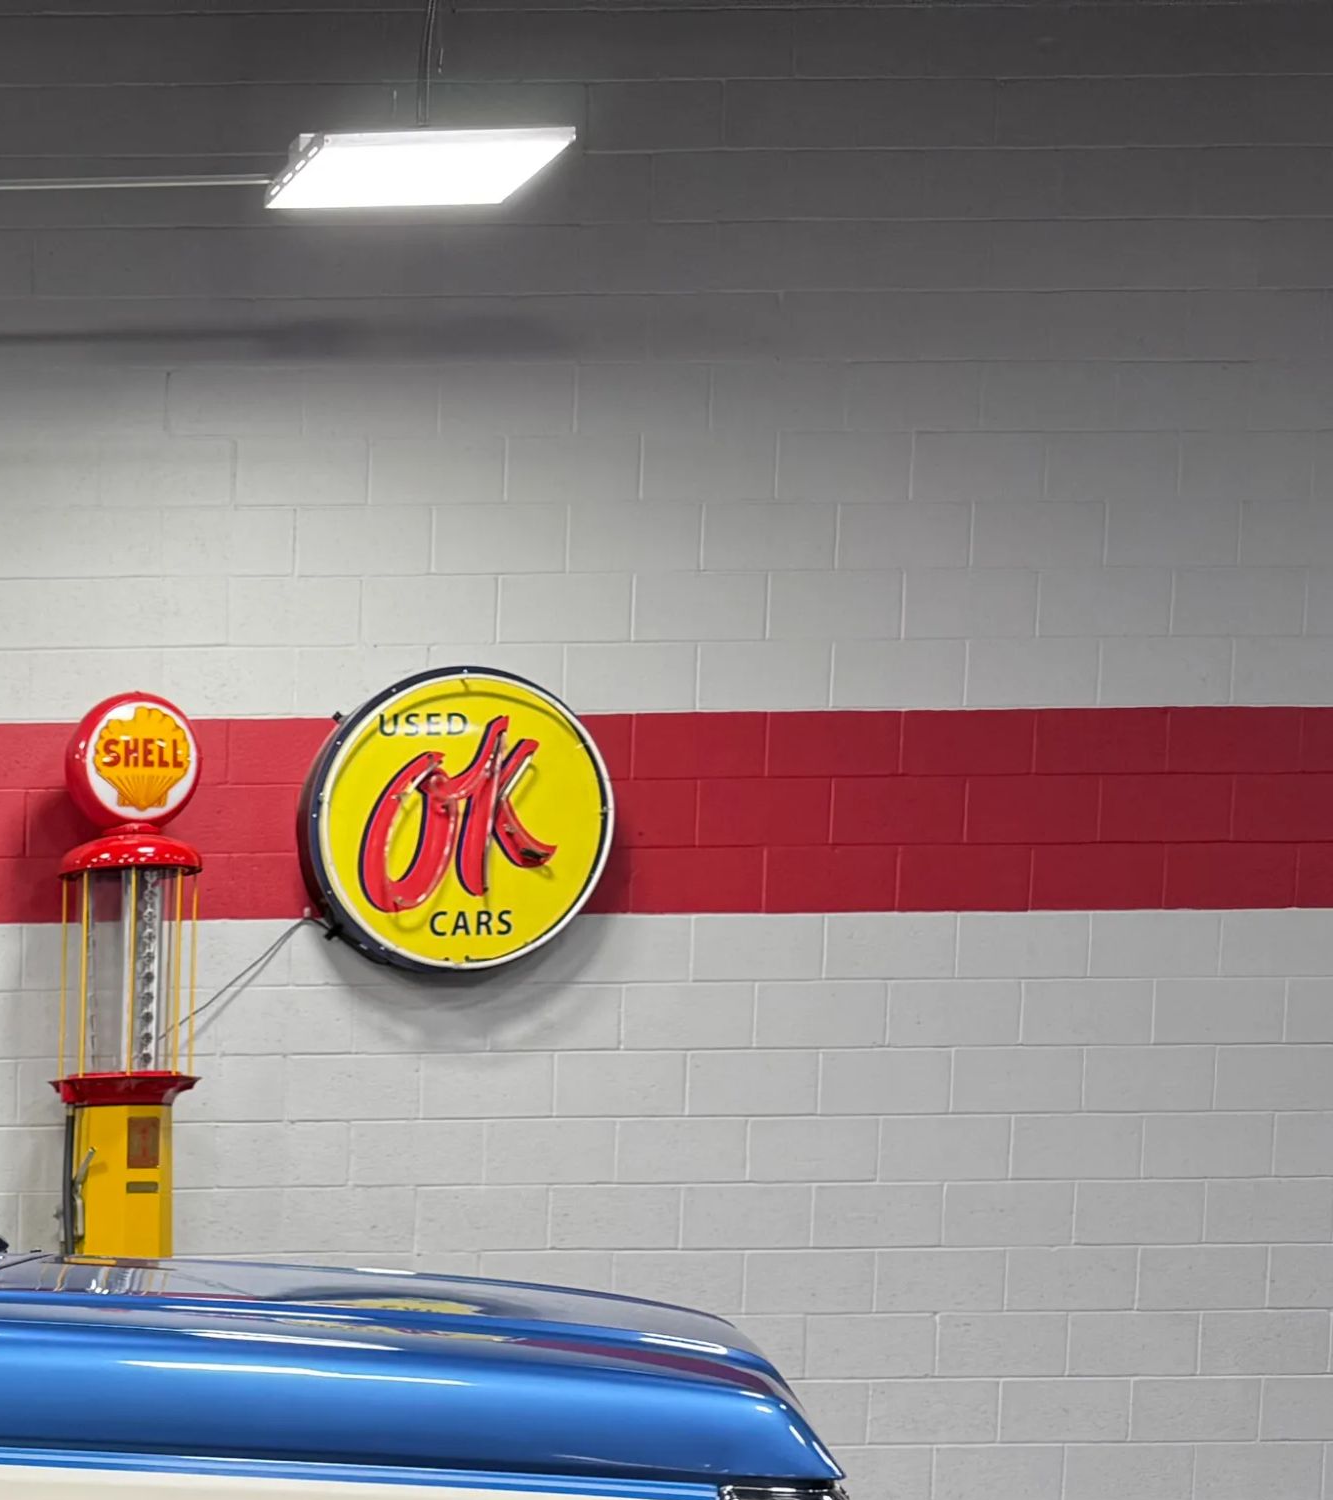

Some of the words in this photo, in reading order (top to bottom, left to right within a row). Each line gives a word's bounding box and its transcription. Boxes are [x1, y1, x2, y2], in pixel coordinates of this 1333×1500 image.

[377, 711, 469, 737] USED
[101, 738, 184, 770] SHELL
[357, 715, 558, 912] OK
[428, 910, 513, 938] CARS
